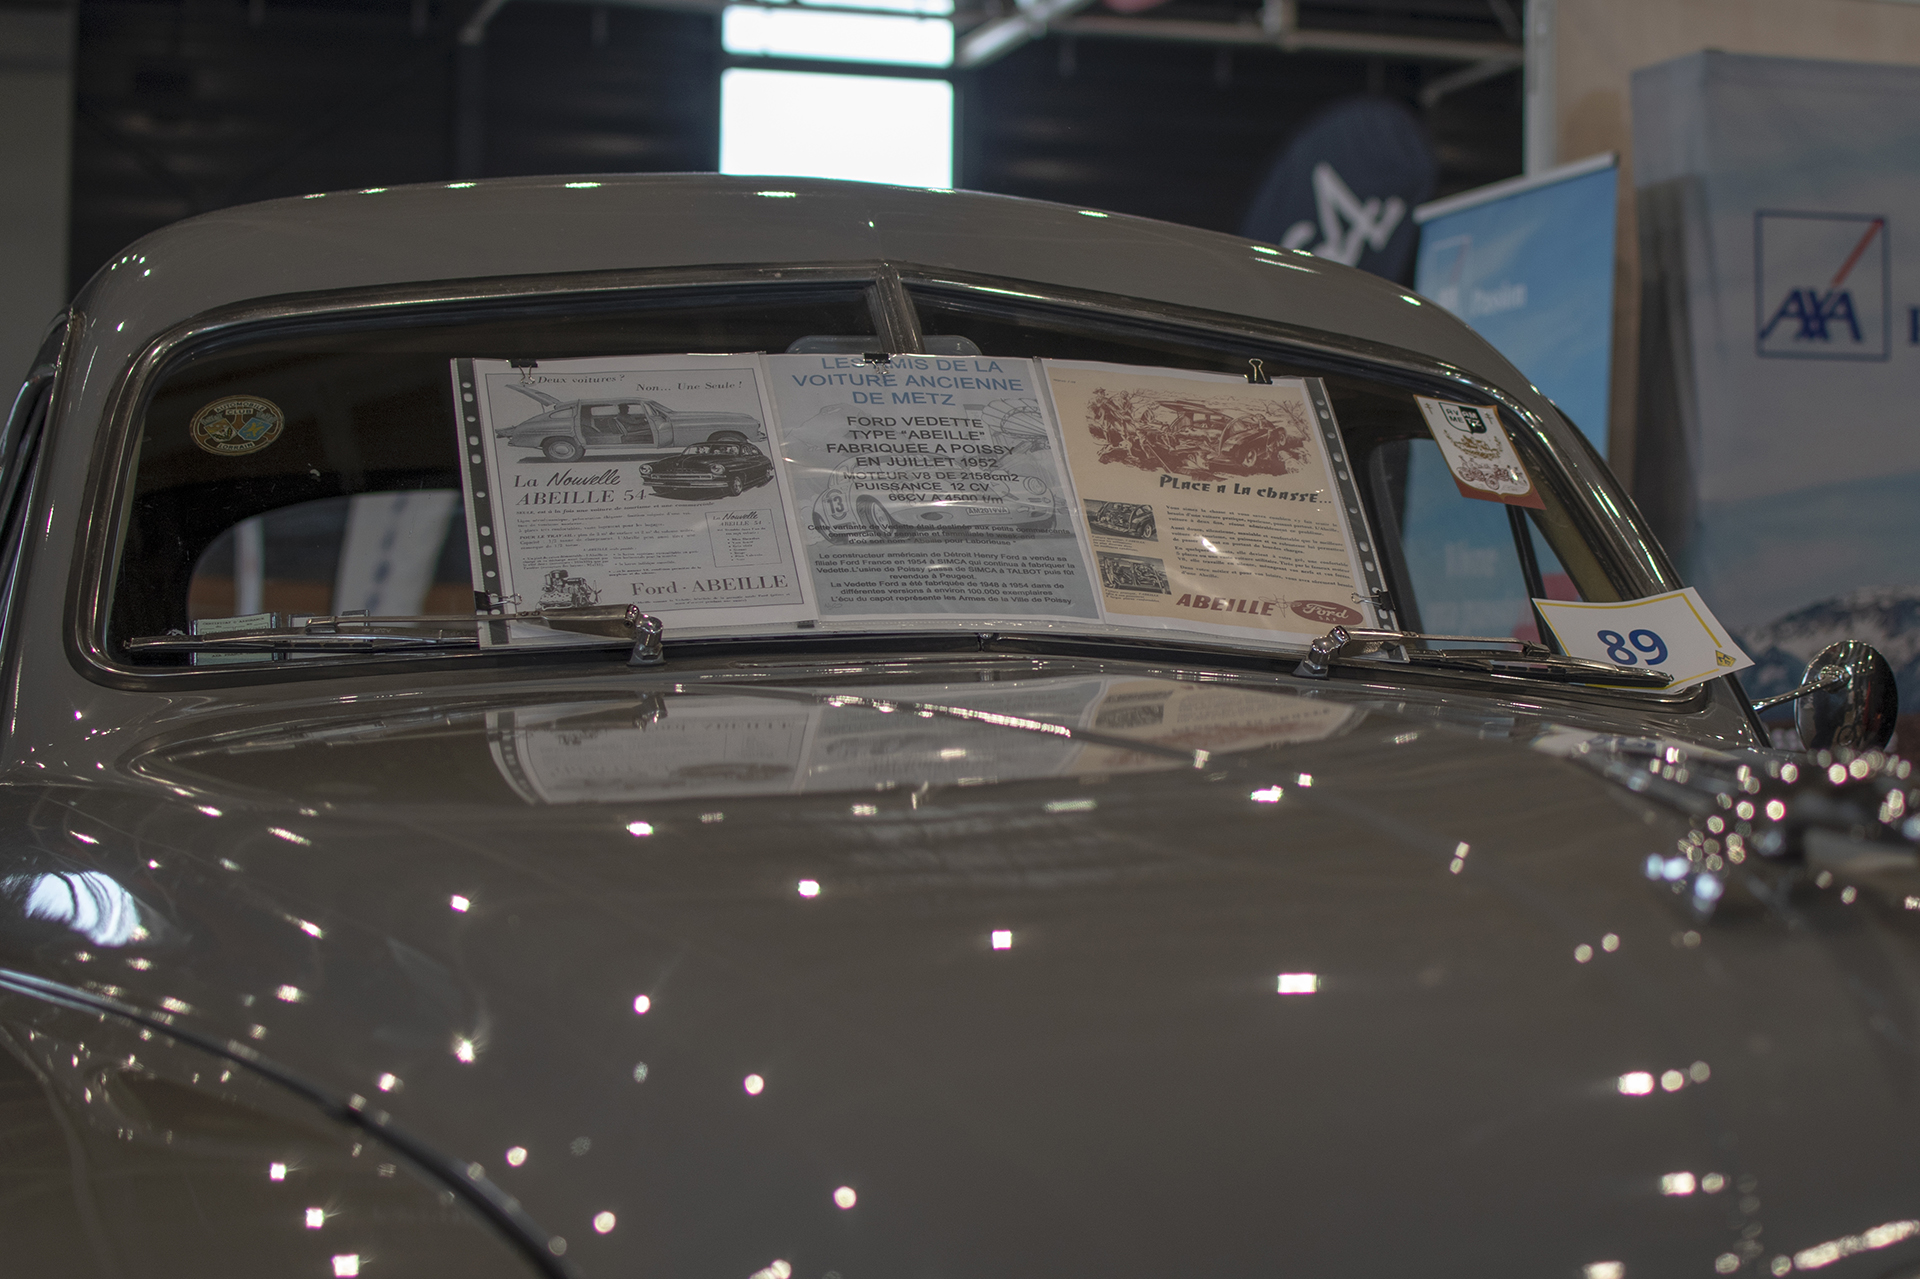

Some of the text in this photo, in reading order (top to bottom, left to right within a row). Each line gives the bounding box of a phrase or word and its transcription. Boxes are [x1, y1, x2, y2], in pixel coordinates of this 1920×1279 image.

[1758, 288, 1862, 342] AXA
[872, 358, 929, 370] MIS
[936, 360, 968, 372] DE
[974, 360, 1004, 374] LA
[538, 376, 567, 384] Deux
[792, 374, 1024, 392] VOITURE ANCIENNE
[678, 382, 701, 390] Une
[704, 381, 736, 390] Seule
[852, 391, 956, 406] DE METZ
[216, 402, 266, 412] AUTOMOBILE
[847, 416, 984, 428] FORD VEDETTE
[849, 430, 897, 440] TYPE
[218, 442, 254, 450] LORRAIN
[826, 444, 1015, 455] FABRIQUEE A POISSY
[856, 457, 999, 468] EN JUILLET 1952
[514, 468, 622, 488] La Nouvelle
[843, 472, 909, 480] MOTEUR
[912, 472, 931, 480] V8
[936, 472, 958, 480] DE
[855, 482, 989, 492] PUISSANCE 12 CV
[516, 489, 647, 506] ABEILLE 54
[888, 494, 926, 502] 66CV
[808, 524, 830, 532] Cette
[974, 552, 998, 560] Henry
[969, 559, 981, 567] qui
[984, 560, 1018, 568] continua
[1028, 561, 1065, 570] fabriquer
[939, 572, 977, 580] Peugeot.
[631, 574, 788, 596] Ford ABEILLE
[925, 580, 965, 588] fabriquée
[1002, 590, 1053, 598] exemplaires
[1044, 597, 1072, 605] Poissy
[1176, 594, 1275, 617] ABEILLE
[1303, 604, 1349, 619] Ford
[1597, 628, 1668, 666] 89
